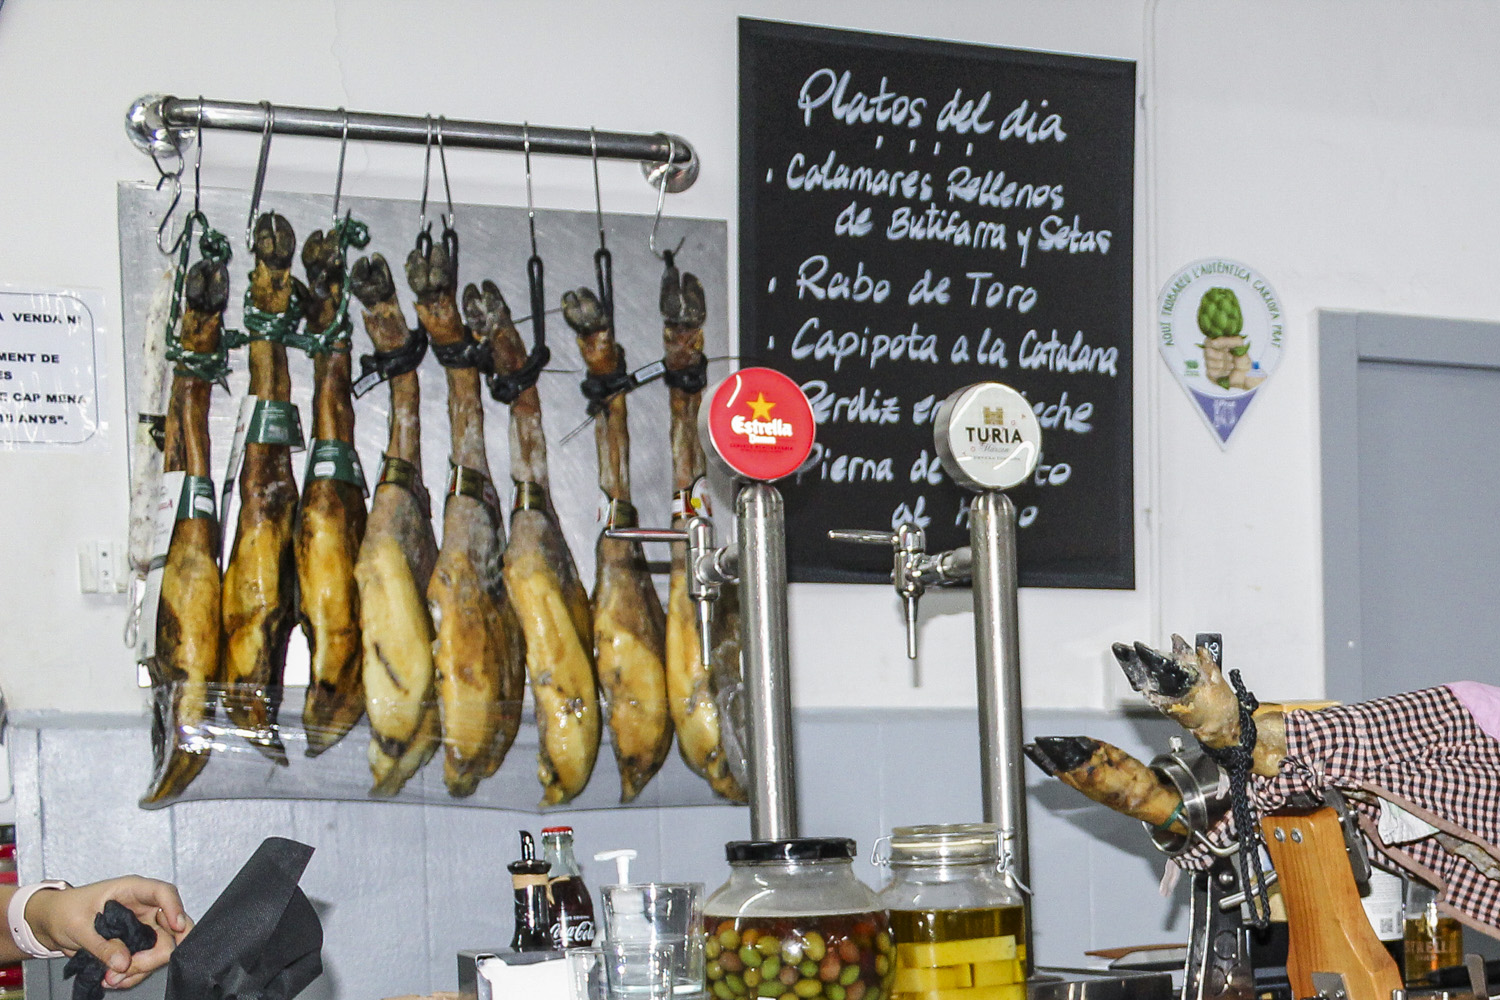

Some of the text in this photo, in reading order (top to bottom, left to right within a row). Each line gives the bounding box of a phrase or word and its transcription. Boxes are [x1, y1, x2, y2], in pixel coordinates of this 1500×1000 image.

[797, 68, 1067, 144] Platos del dia
[786, 150, 1065, 211] Calamares Rellenos
[834, 200, 1113, 268] de Butifarra y Setas
[796, 254, 1039, 314] Rabo de Toro
[13, 312, 62, 323] VENDA
[41, 354, 60, 364] DE
[791, 316, 1119, 377] Capipota a la Catalana
[13, 392, 41, 403] CAP
[800, 379, 901, 425] Perdiz
[731, 414, 794, 437] Estrella
[965, 427, 1023, 443] TURIA
[796, 441, 943, 486] Pierna de
